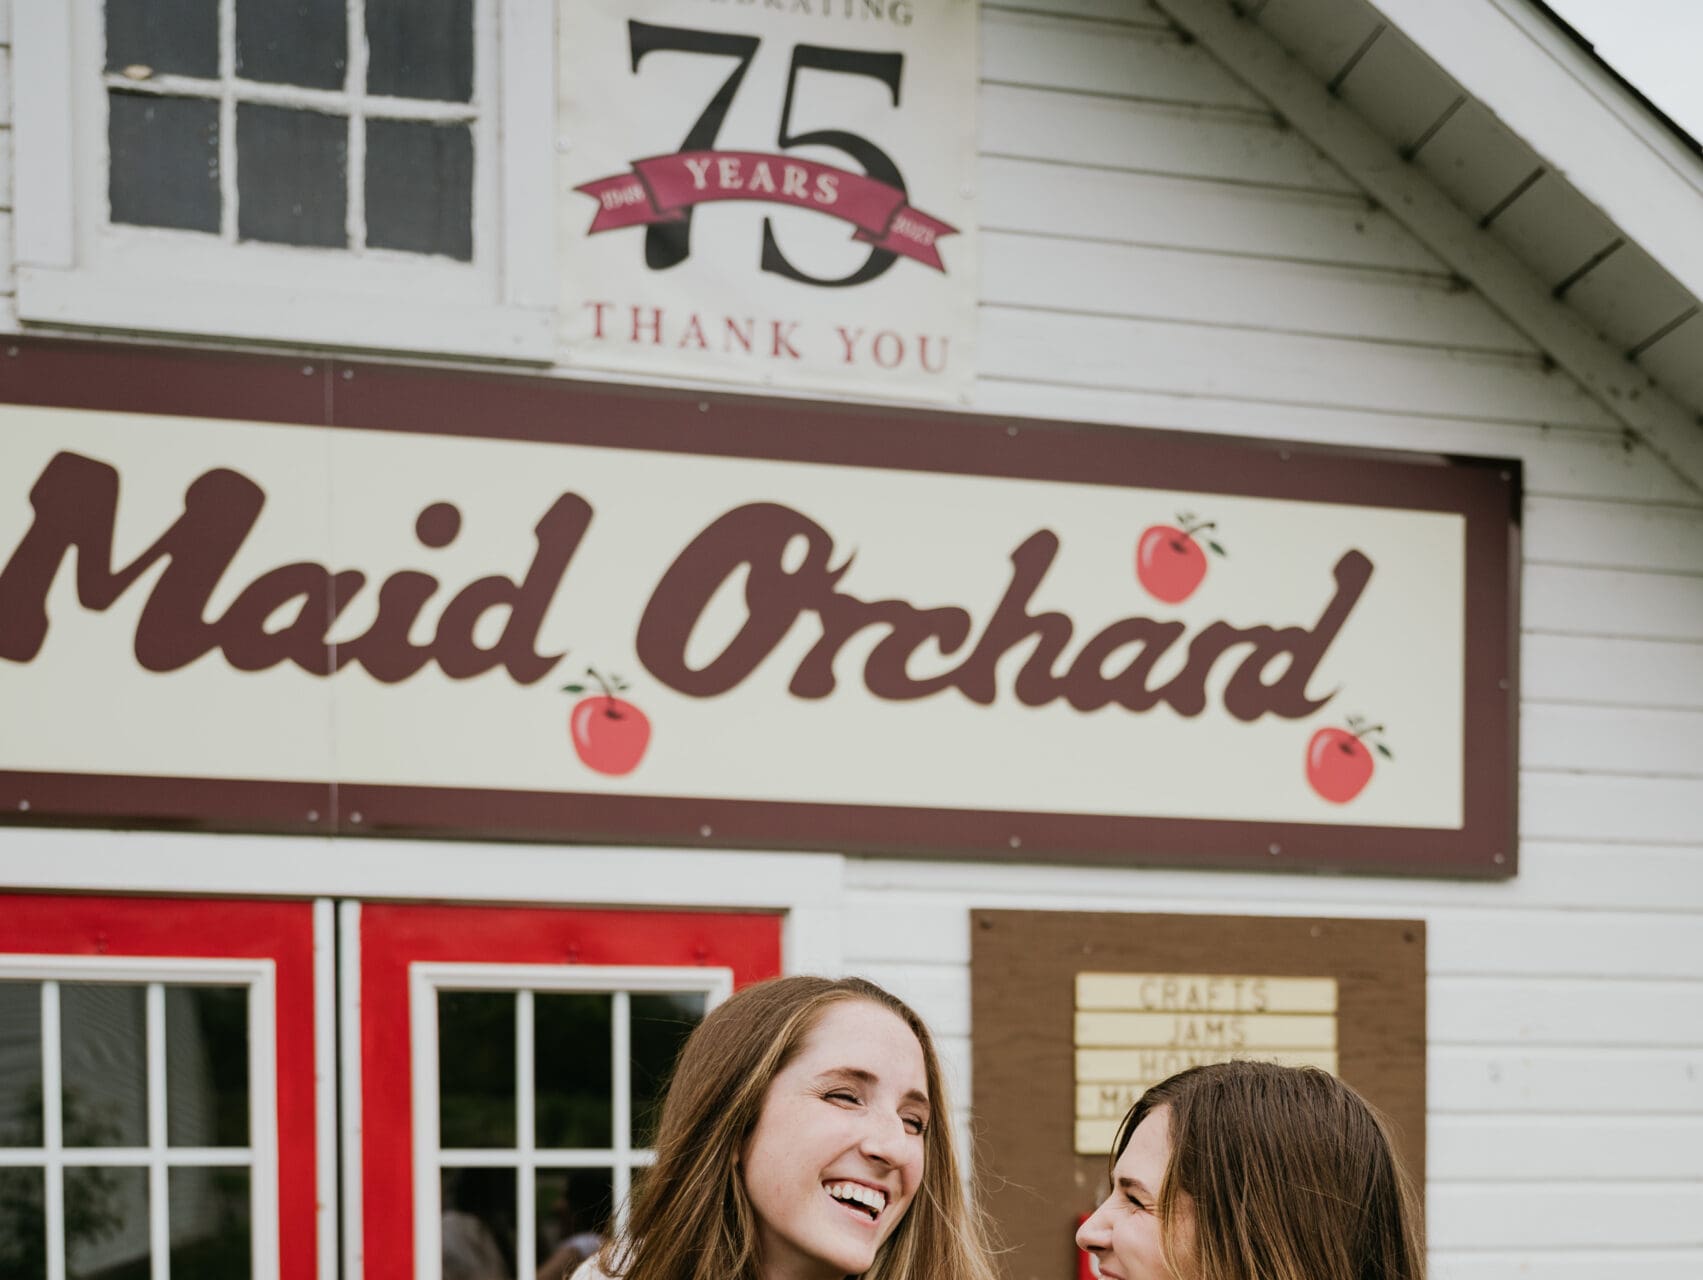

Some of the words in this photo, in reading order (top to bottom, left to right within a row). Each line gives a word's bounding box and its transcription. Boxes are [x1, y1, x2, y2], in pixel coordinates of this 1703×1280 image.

[628, 19, 909, 288] 75
[684, 158, 840, 205] YEARS
[583, 301, 803, 361] THANK
[836, 325, 951, 375] YOU
[0, 450, 594, 686] Maid
[635, 501, 1374, 722] Orchard
[1140, 977, 1268, 1013] CRAFTS
[1169, 1016, 1247, 1048] JAMS
